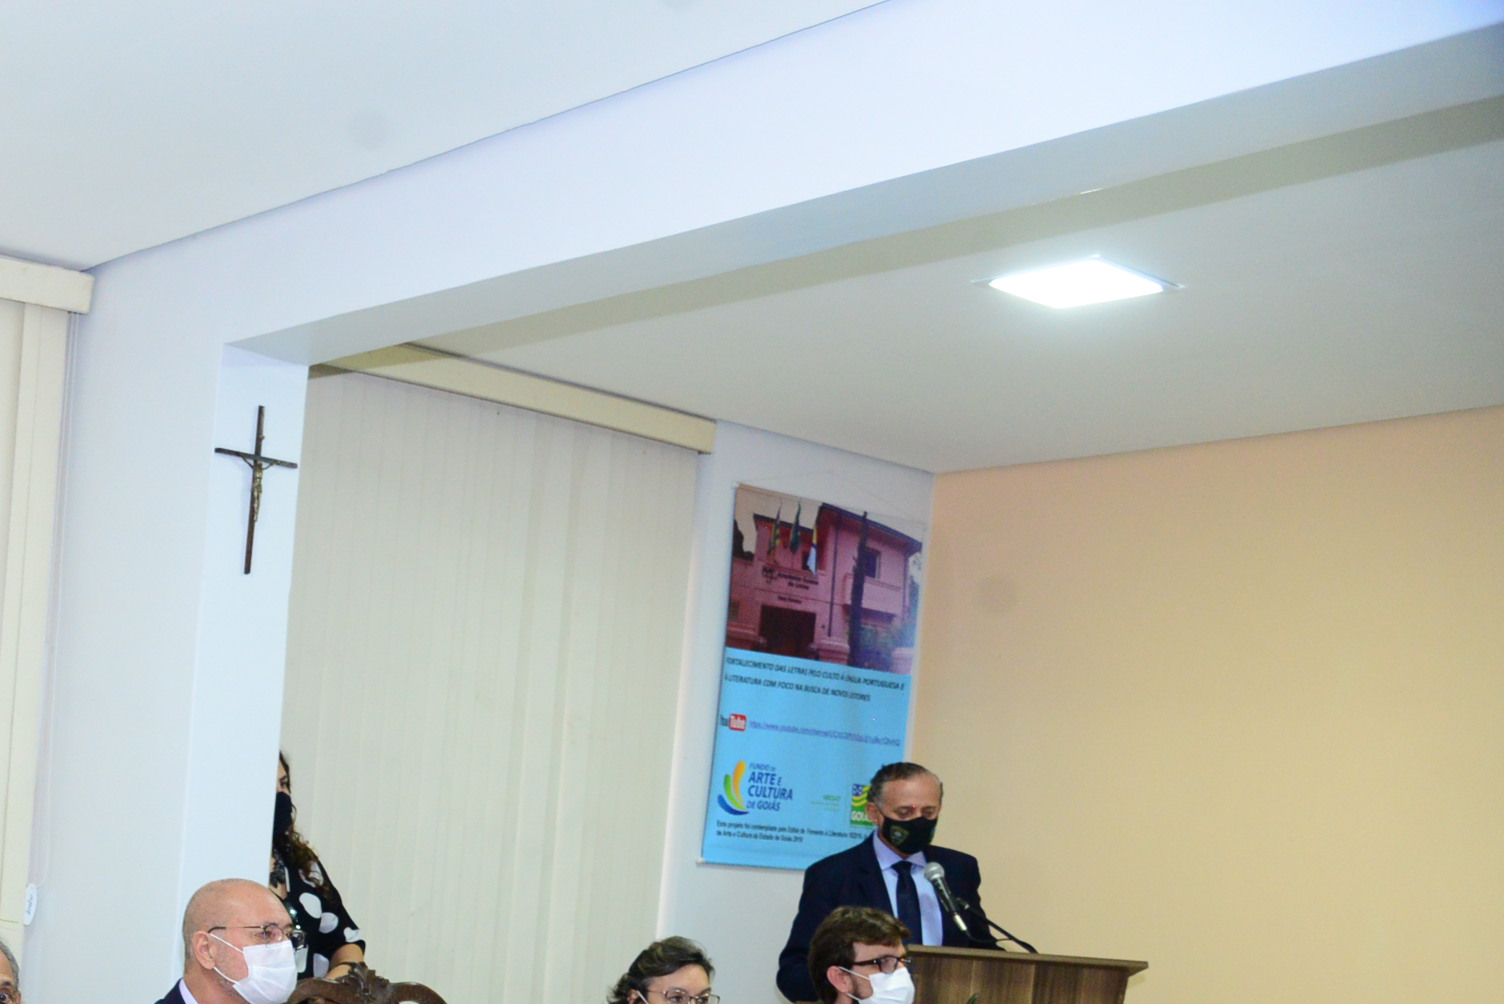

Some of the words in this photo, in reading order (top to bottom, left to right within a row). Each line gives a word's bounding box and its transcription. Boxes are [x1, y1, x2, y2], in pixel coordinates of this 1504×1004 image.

[762, 680, 777, 688] COM
[778, 681, 794, 690] FOCO
[788, 666, 808, 676] LETRAS
[863, 678, 899, 690] PORTUGUESA
[748, 771, 776, 785] ARTE
[777, 776, 782, 786] E
[748, 785, 793, 800] CULTURA
[746, 800, 756, 809] DE
[757, 800, 781, 812] GOIÁS
